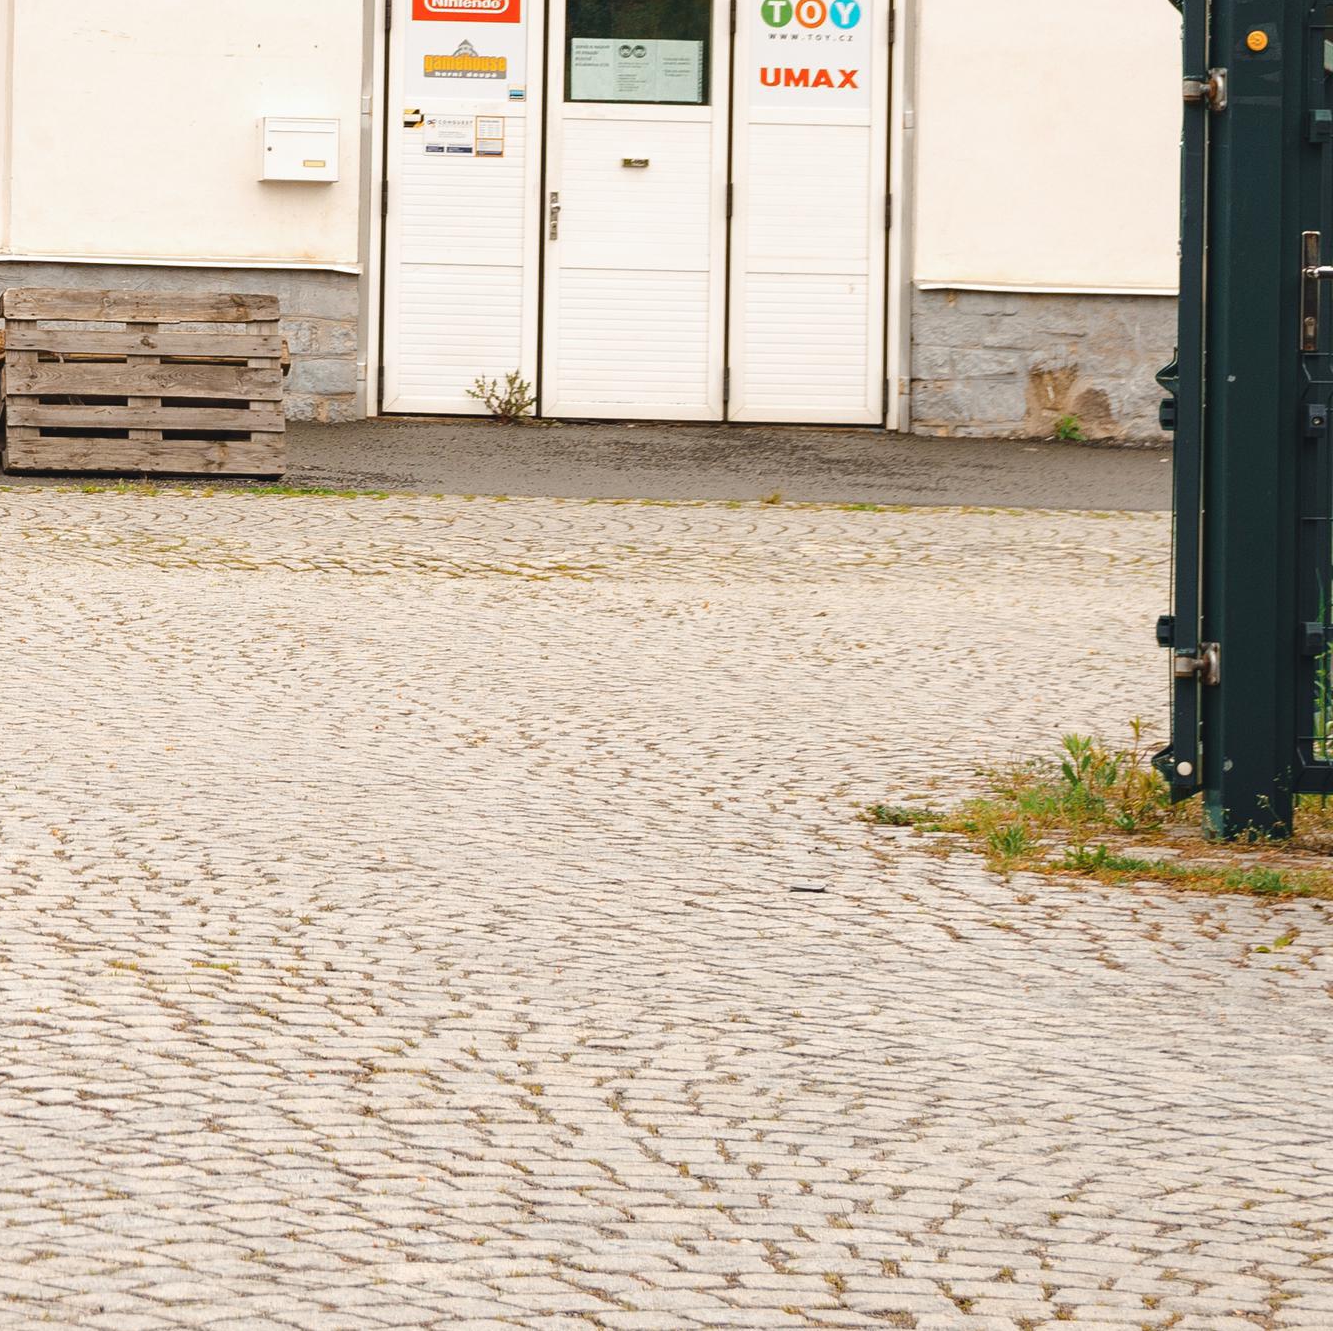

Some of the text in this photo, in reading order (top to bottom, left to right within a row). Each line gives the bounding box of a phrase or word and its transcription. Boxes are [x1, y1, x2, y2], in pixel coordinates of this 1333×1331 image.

[767, 0, 856, 26] TOY
[768, 33, 853, 41] WWW.TOY.CZ
[760, 67, 859, 88] UMAX
